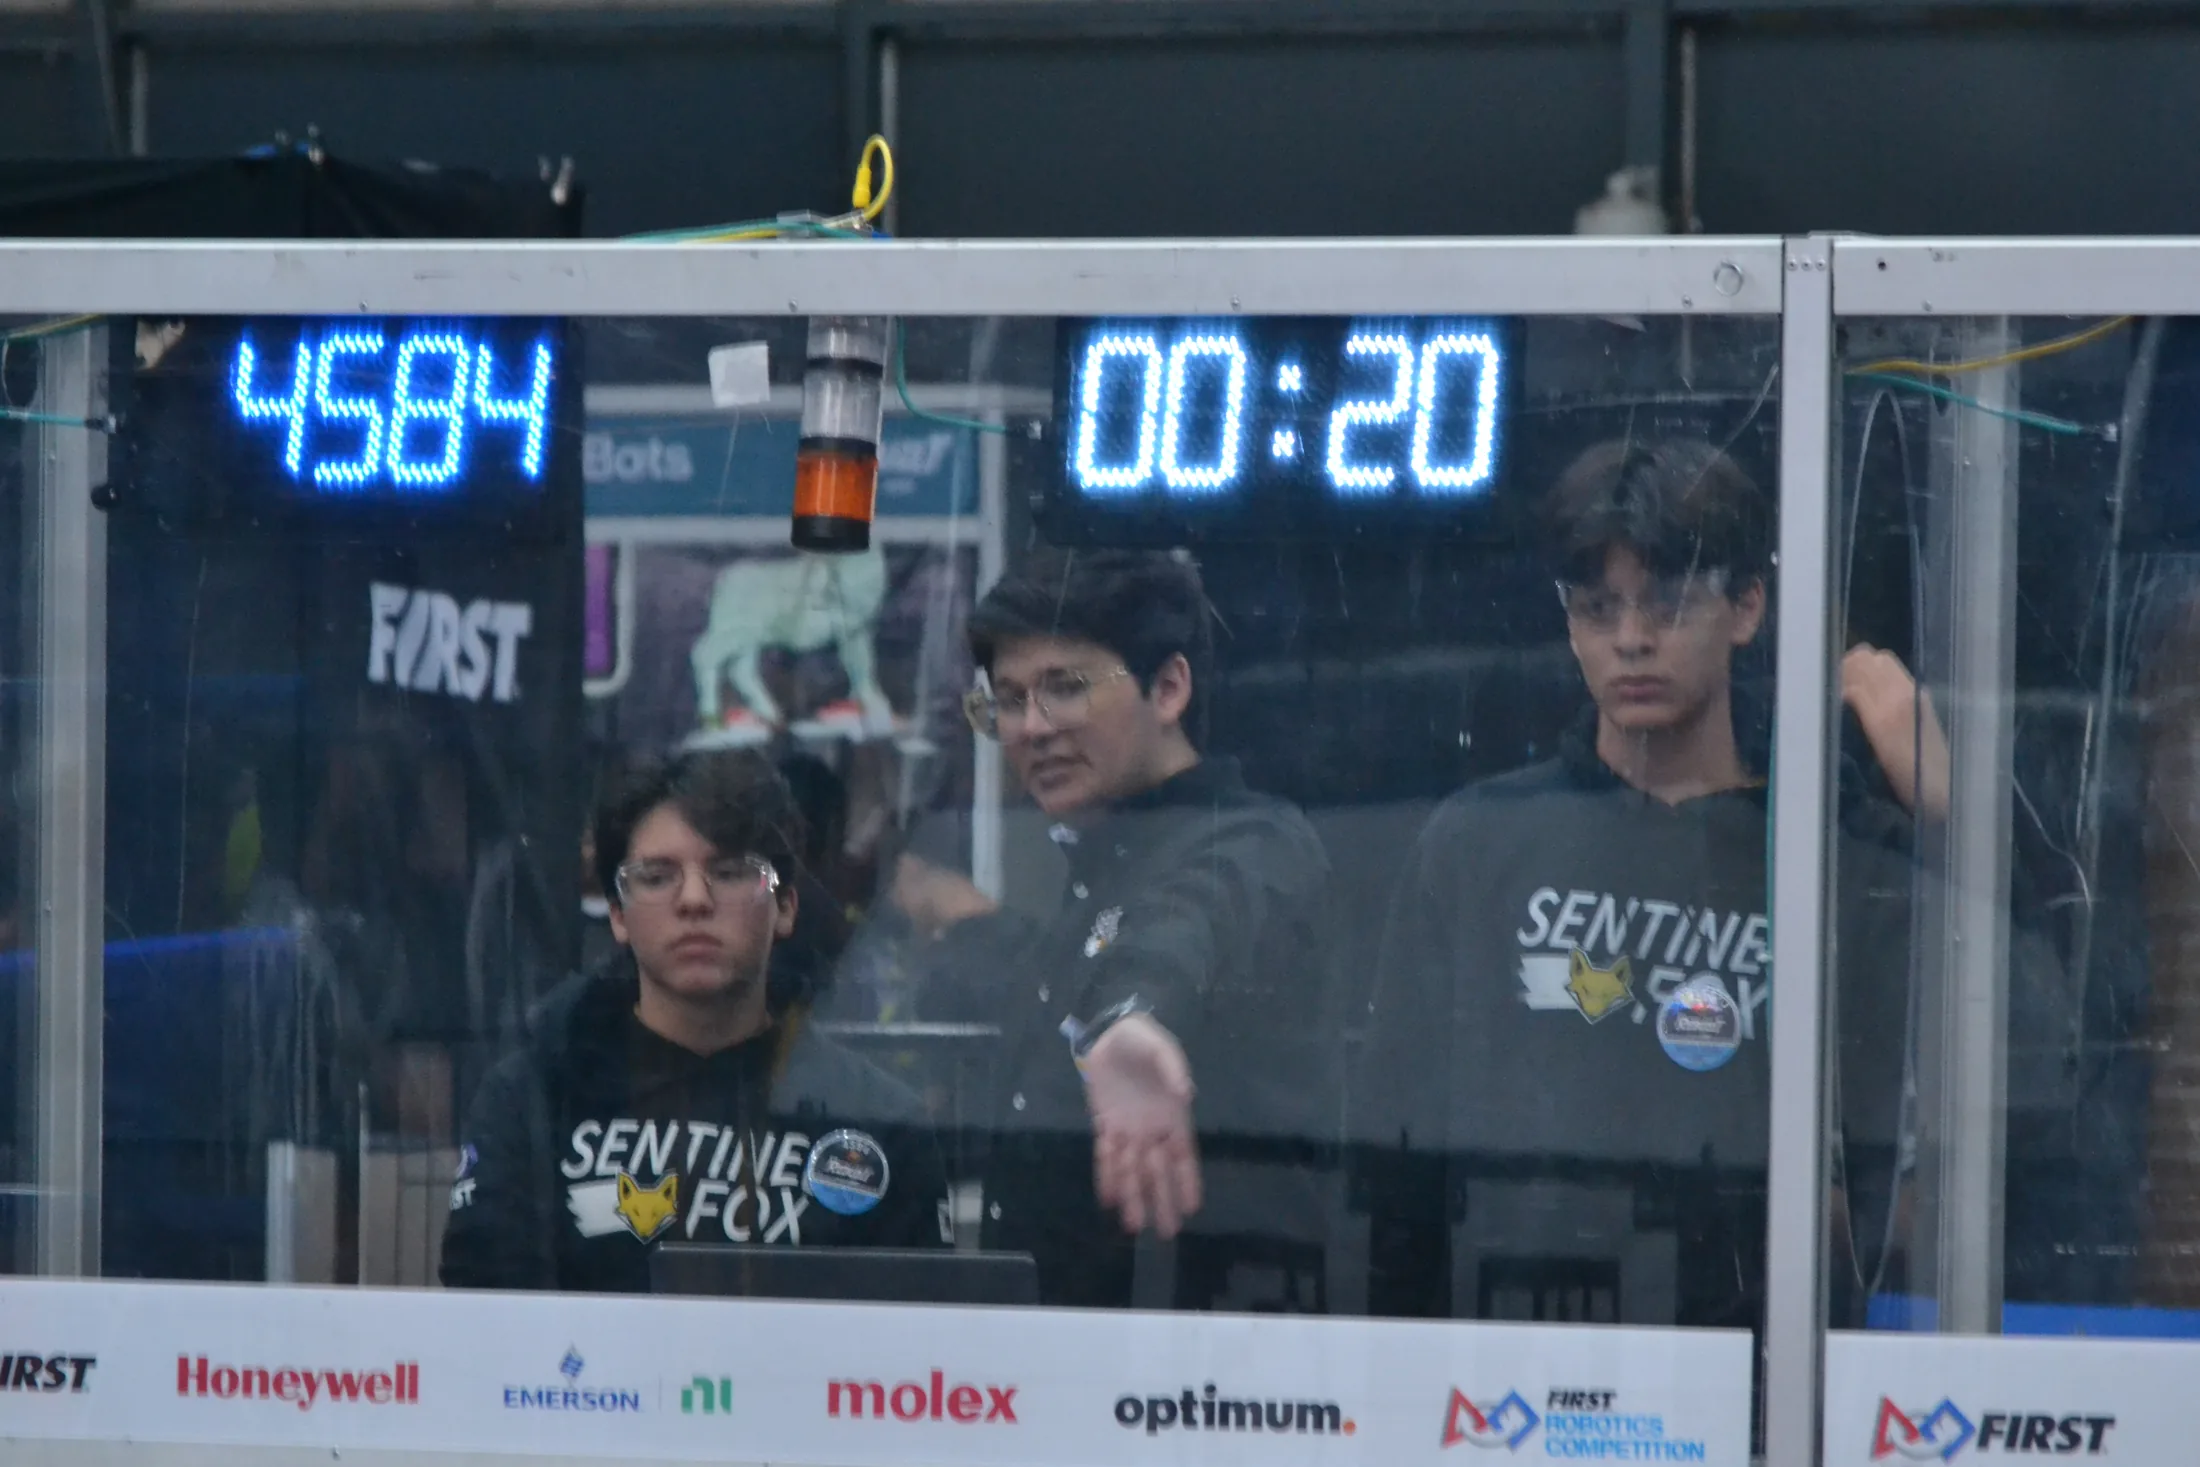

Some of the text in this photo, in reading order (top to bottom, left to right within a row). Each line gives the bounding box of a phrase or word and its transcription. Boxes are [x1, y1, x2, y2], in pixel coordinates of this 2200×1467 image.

[232, 333, 552, 486] 4584
[1075, 333, 1500, 490] 00:20
[368, 581, 532, 702] FIRST
[685, 1178, 810, 1246] FOX
[176, 1355, 419, 1411] Honeywell
[503, 1387, 640, 1412] EMERSON
[827, 1368, 1018, 1424] molex
[1547, 1388, 1617, 1411] FIRST
[1544, 1414, 1664, 1437] ROBOTICS
[1544, 1437, 1705, 1463] COMPETITION
[1975, 1412, 2116, 1455] FIRST
